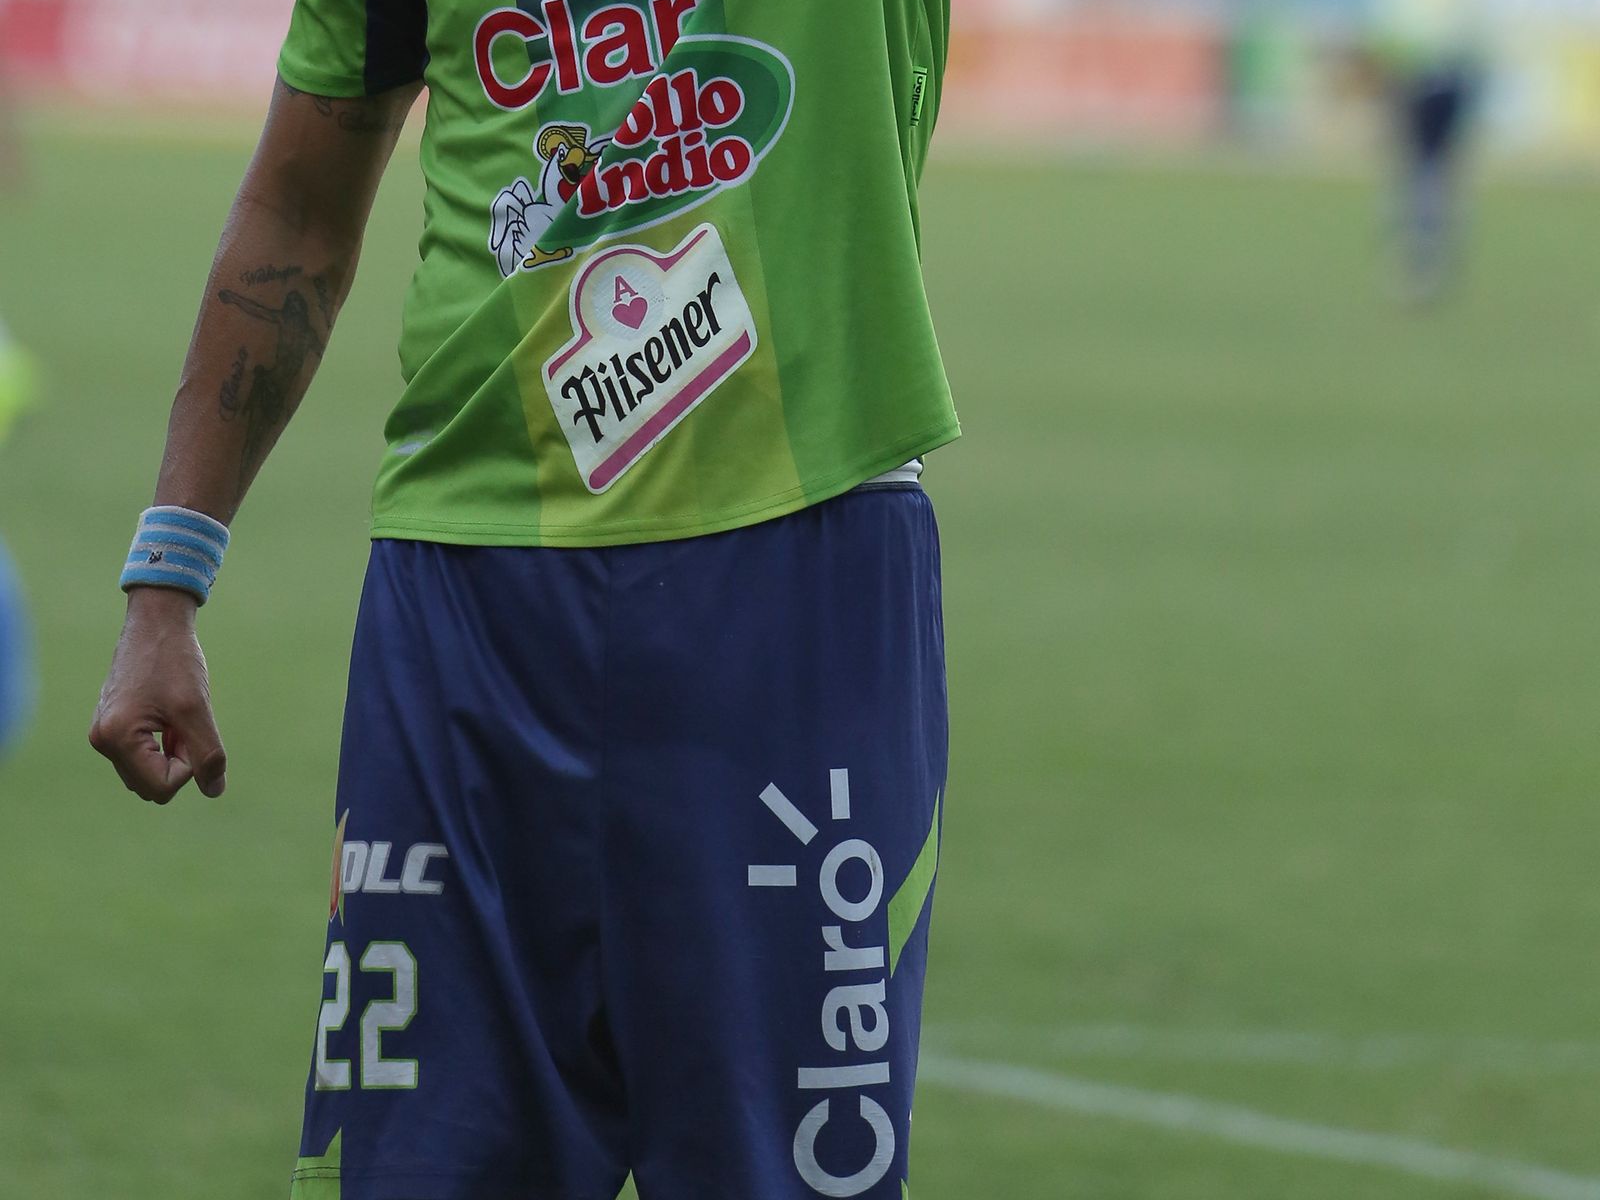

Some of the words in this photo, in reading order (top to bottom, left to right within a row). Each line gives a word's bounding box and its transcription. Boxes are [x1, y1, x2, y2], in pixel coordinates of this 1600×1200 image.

[613, 71, 742, 145] ollo
[579, 130, 751, 216] Indio
[613, 275, 639, 303] A
[561, 271, 721, 444] Pilsener
[314, 940, 419, 1091] 22
[792, 838, 896, 1198] Claro
